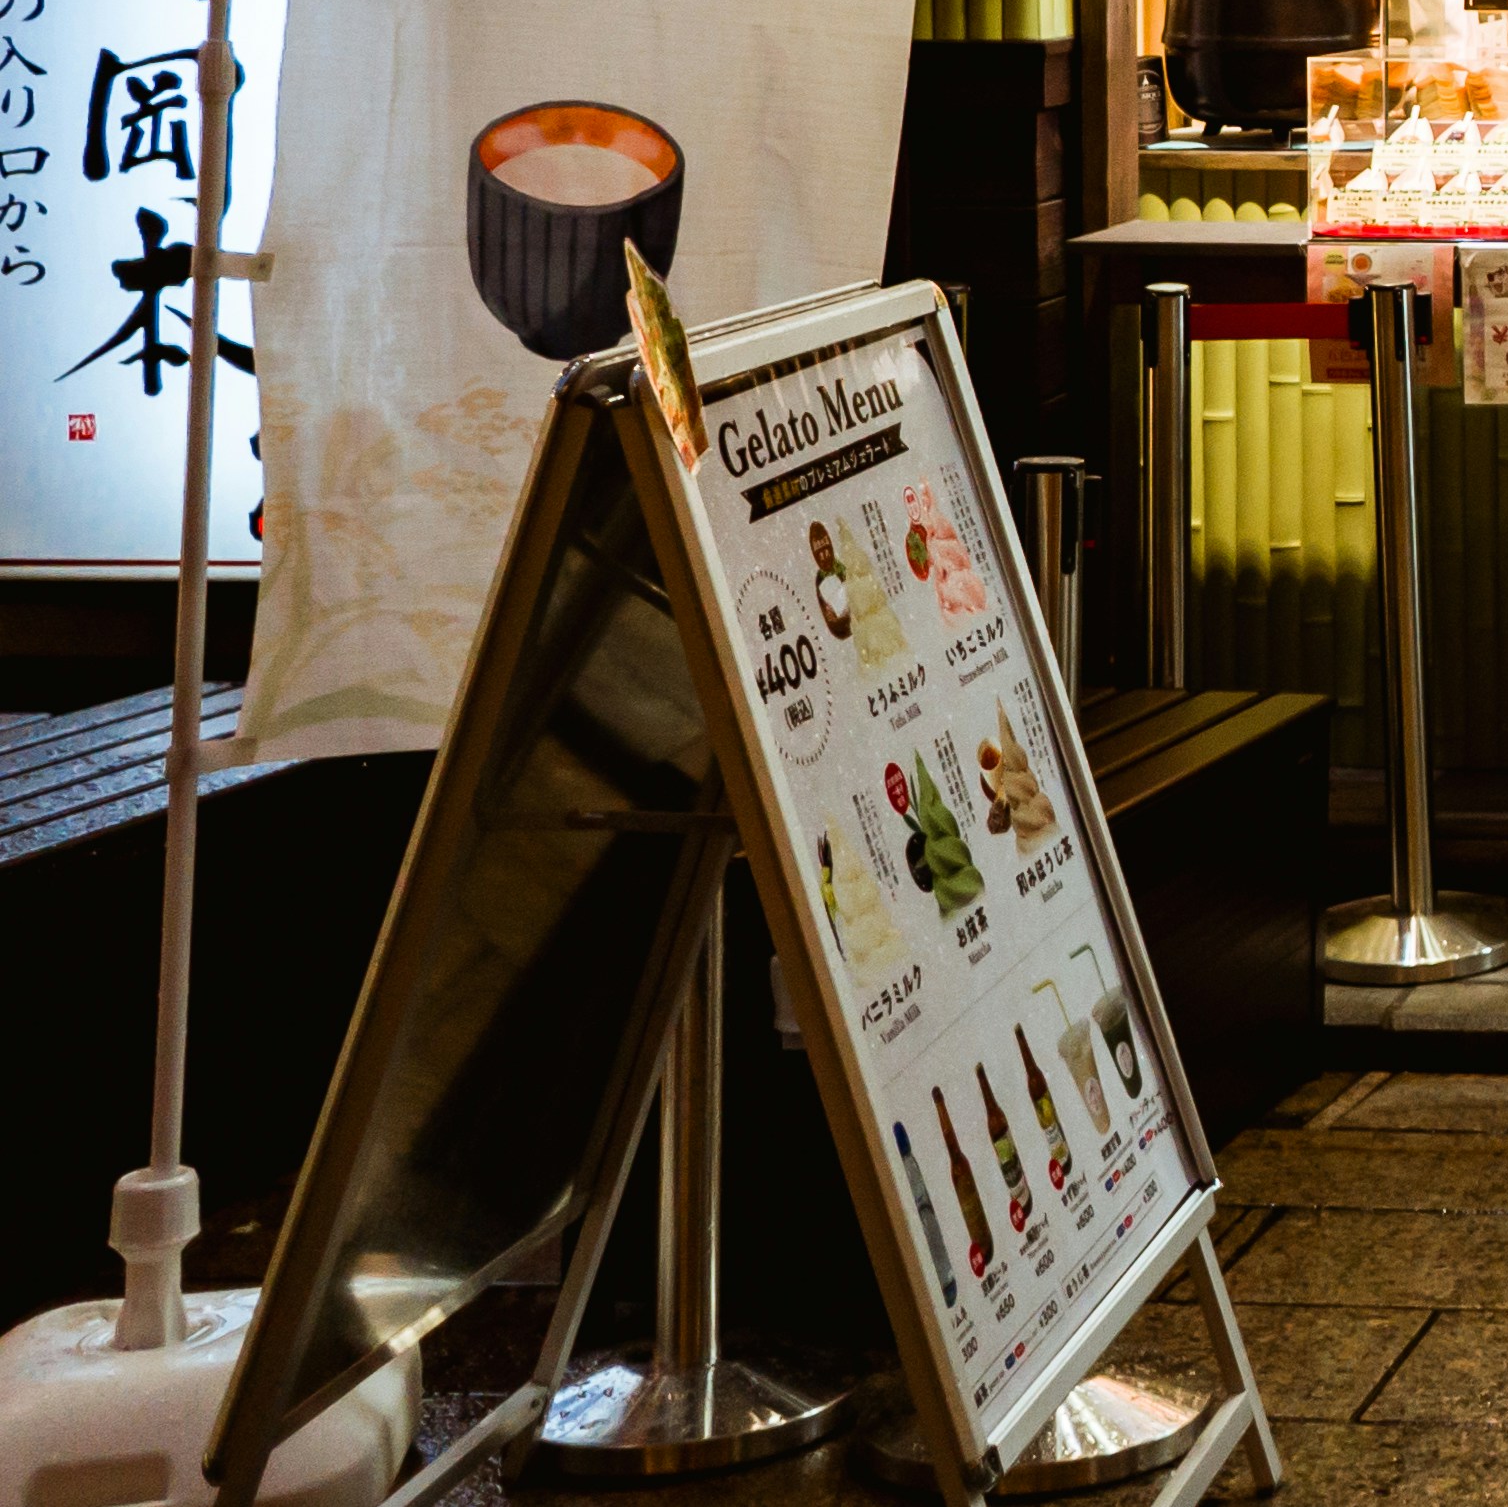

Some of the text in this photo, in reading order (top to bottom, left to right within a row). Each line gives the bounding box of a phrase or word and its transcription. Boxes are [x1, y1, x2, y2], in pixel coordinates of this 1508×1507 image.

[718, 377, 905, 479] Gelato Menu
[944, 615, 1007, 668] いちごミルク
[866, 661, 928, 719] とうふミルク
